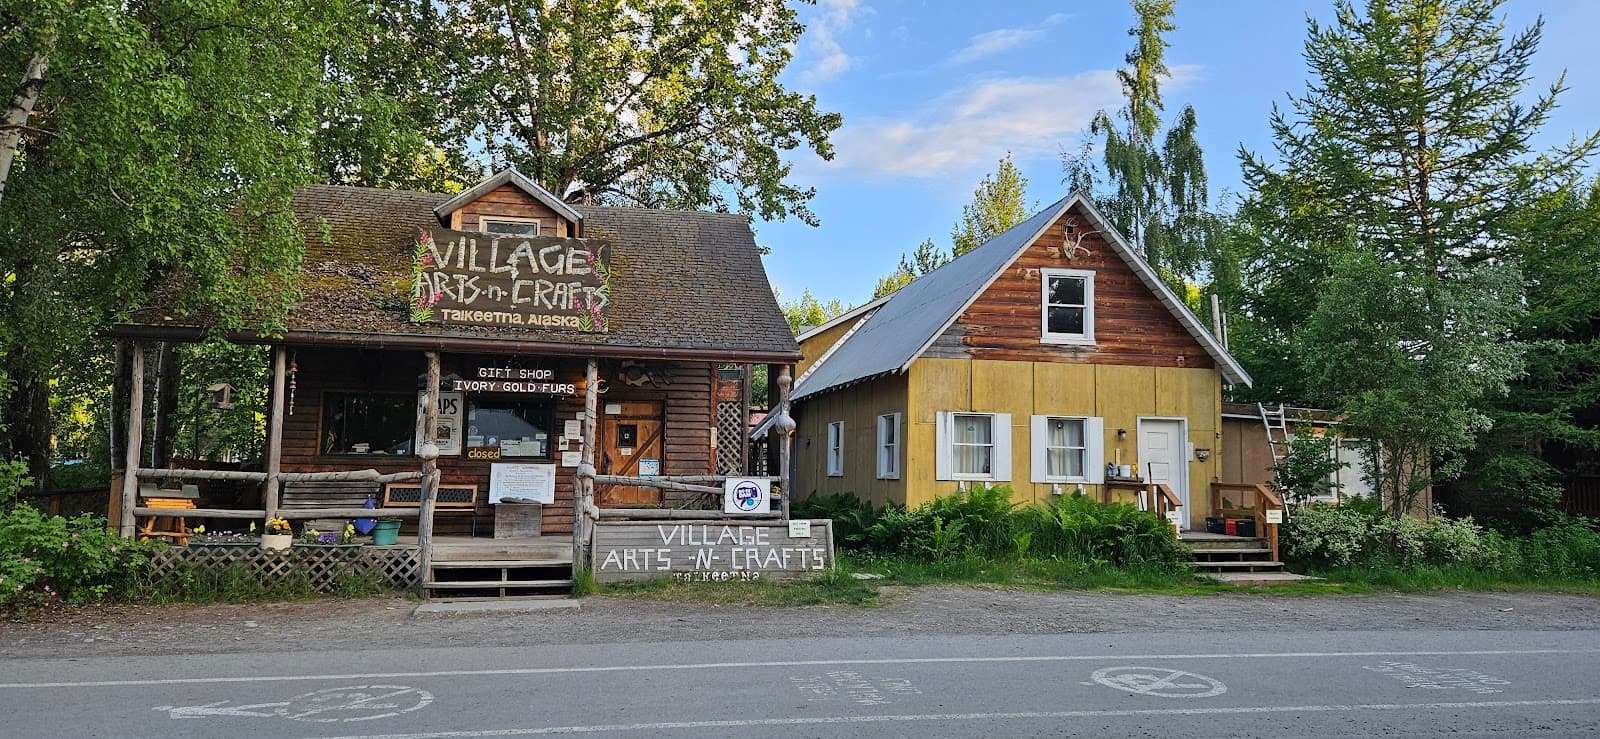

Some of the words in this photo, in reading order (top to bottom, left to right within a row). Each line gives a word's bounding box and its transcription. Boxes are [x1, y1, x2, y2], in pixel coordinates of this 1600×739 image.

[427, 236, 592, 275] VILLAGE
[415, 272, 481, 305] ARTS
[511, 278, 609, 310] CRAFTS
[479, 367, 511, 378] GIFT
[520, 369, 552, 379] SHOP
[454, 380, 496, 391] IVORY
[503, 381, 536, 392] GOLD
[542, 383, 575, 394] FURS
[468, 448, 500, 459] closed
[657, 525, 770, 546] VILLAGE
[601, 548, 671, 571] ARTS
[731, 547, 825, 570] CRAFTS
